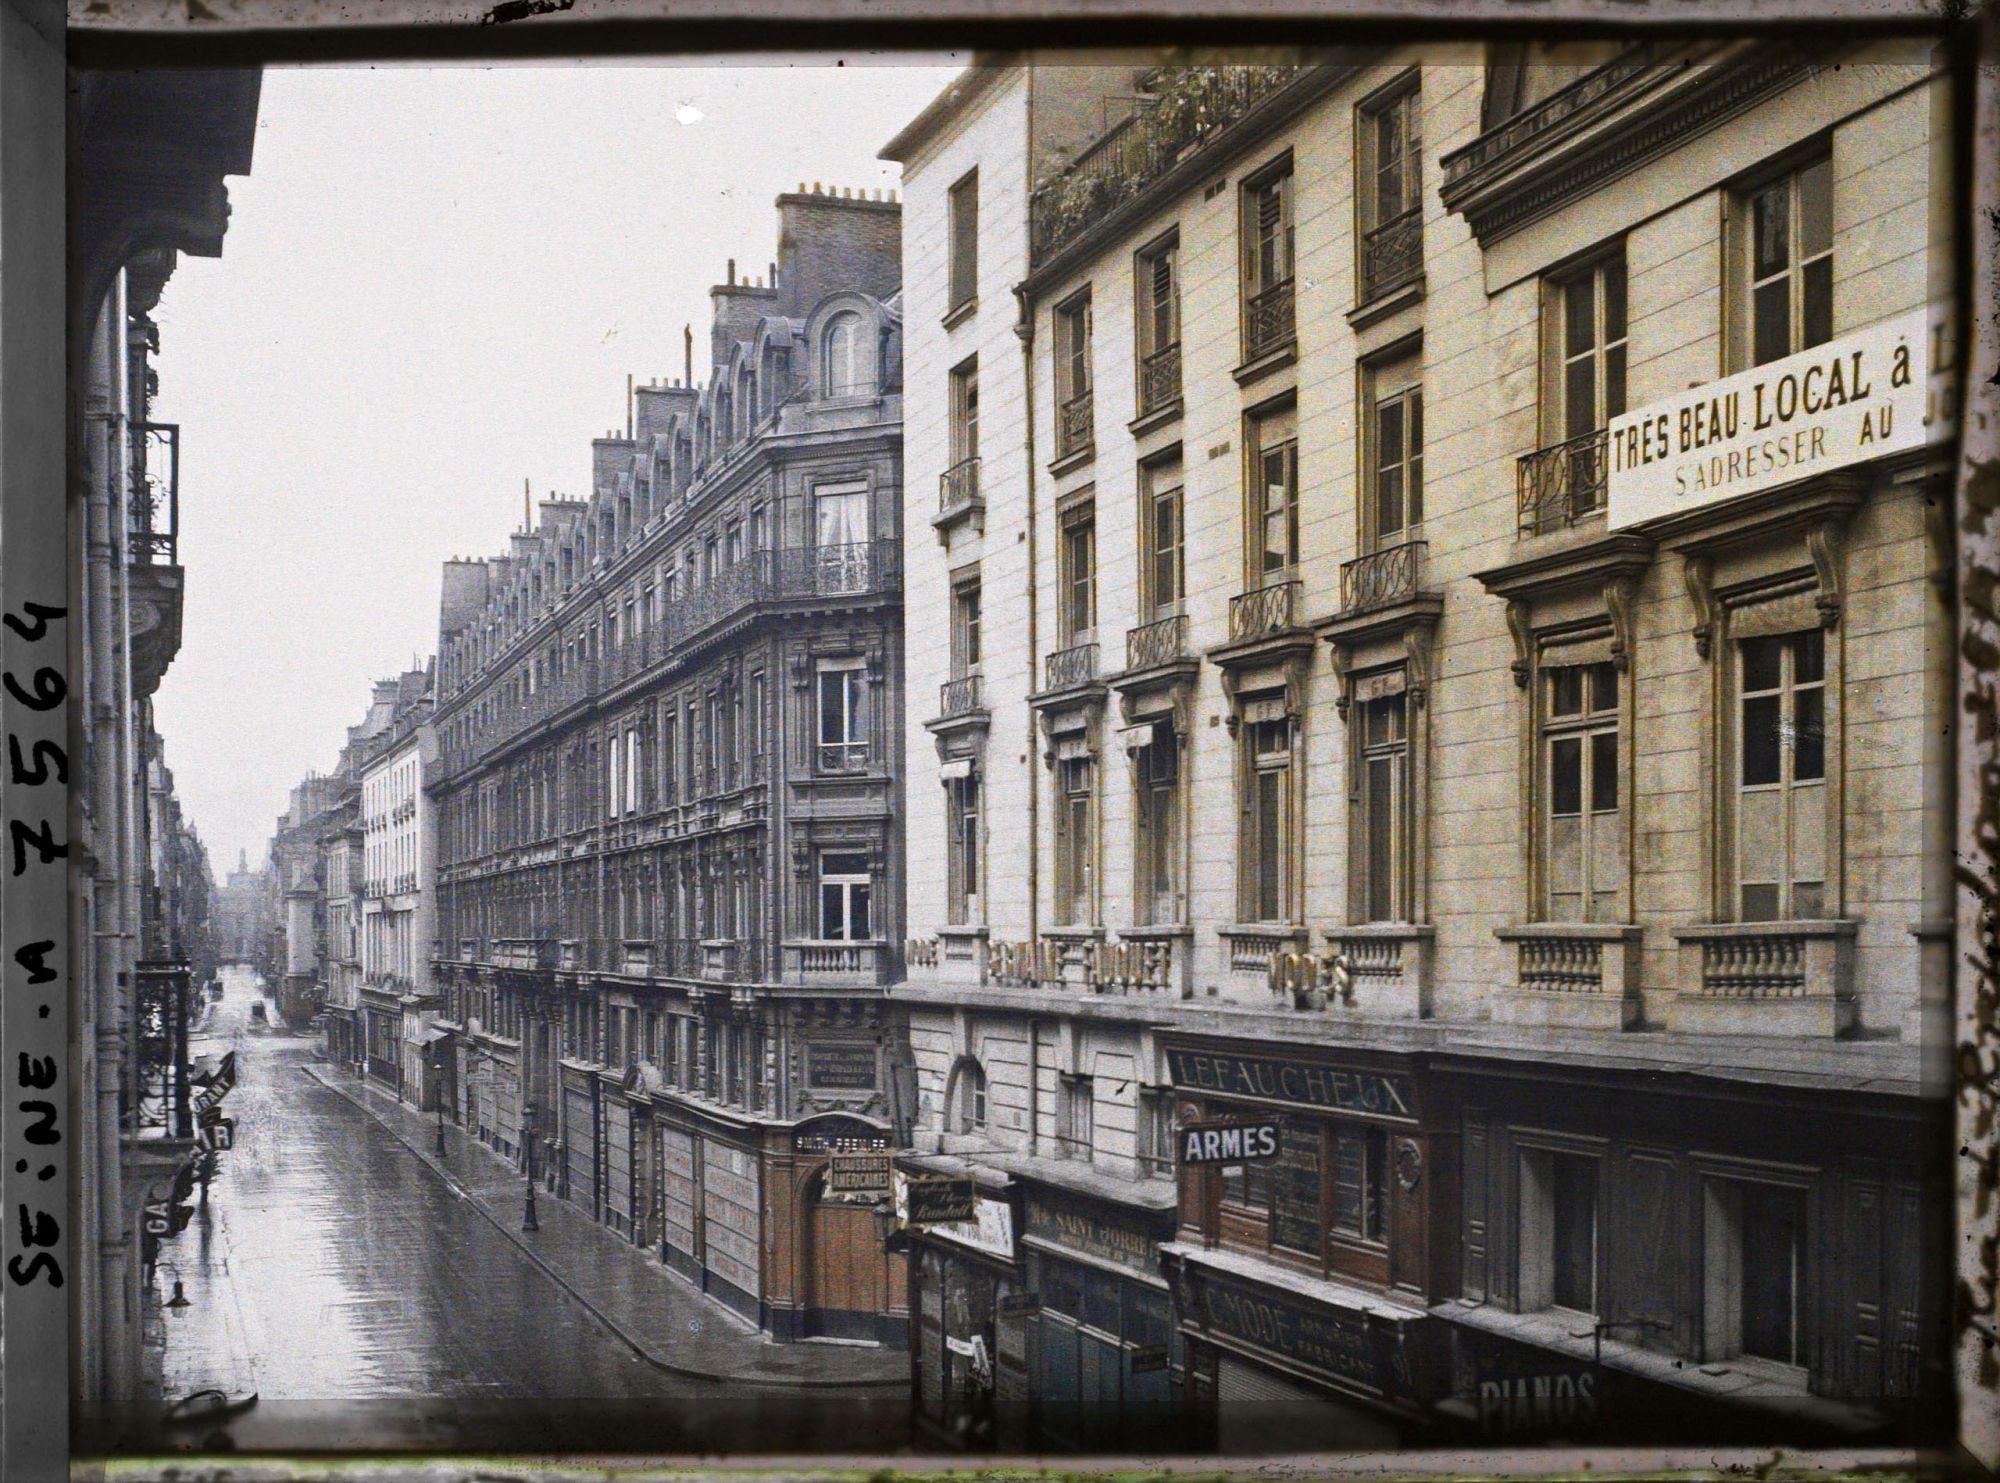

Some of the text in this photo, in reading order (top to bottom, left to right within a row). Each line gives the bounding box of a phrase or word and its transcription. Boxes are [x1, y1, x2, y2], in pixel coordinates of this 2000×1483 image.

[1680, 391, 1738, 453] BEAU
[1753, 351, 1871, 431] LOCAL
[1860, 405, 1892, 446] AU
[2, 601, 68, 877] 7564
[1178, 1055, 1409, 1115] LEFAUCHEUX
[833, 1158, 889, 1171] CHAUSSURES
[1184, 1126, 1277, 1162] ARMES
[1480, 1371, 1595, 1424] PIANOS
